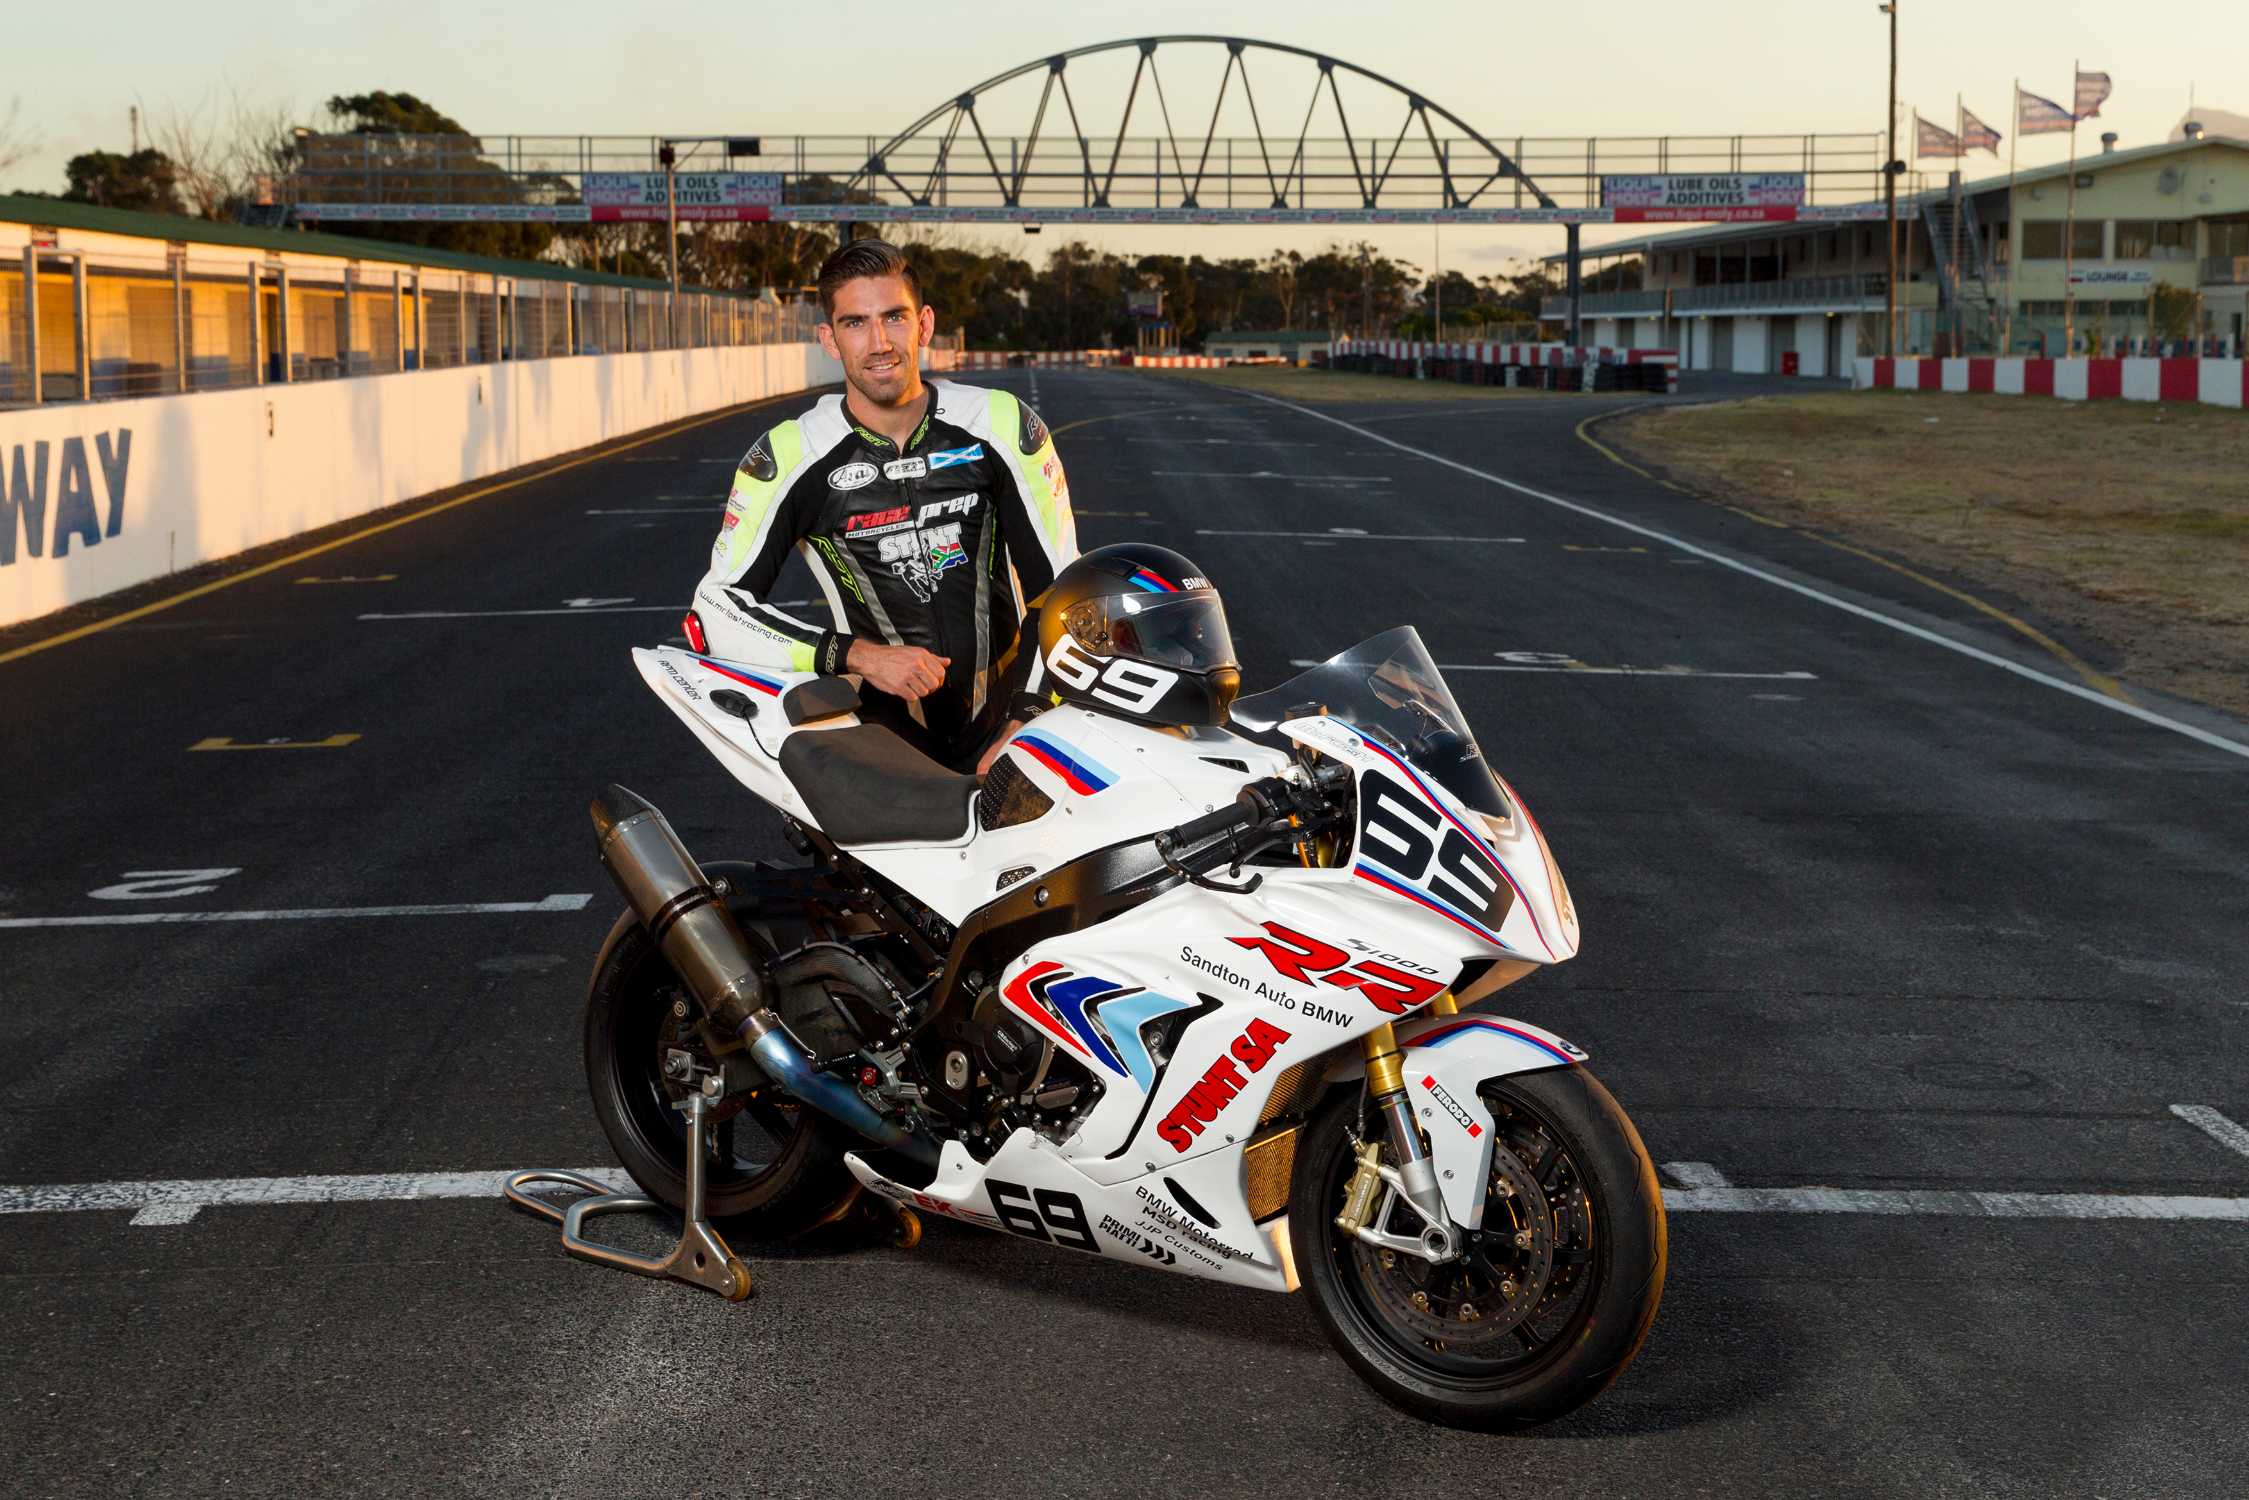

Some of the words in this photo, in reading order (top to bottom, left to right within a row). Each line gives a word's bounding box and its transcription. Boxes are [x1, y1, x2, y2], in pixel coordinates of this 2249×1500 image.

[645, 191, 721, 203] ADITIVES
[646, 176, 680, 189] LUE
[686, 176, 719, 190] OILS
[1666, 192, 1744, 205] ADDITIVES
[1668, 178, 1703, 191] LUBE
[1708, 177, 1742, 191] OILS
[0, 428, 132, 566] WAY
[916, 492, 979, 528] prep
[847, 522, 906, 538] MOTORCYCLES
[1182, 578, 1207, 591] BMW
[826, 634, 839, 673] RST
[1046, 633, 1179, 714] 69
[1359, 768, 1516, 933] 69
[1224, 920, 1448, 1016] RR
[1337, 938, 1440, 976] S1000
[1180, 946, 1250, 990] Sandton
[1255, 981, 1296, 1010] Auto
[1301, 1001, 1354, 1028] BMW
[1157, 1054, 1249, 1153] STUNT
[1231, 1017, 1292, 1074] SA
[1432, 1085, 1471, 1127] FERODO
[913, 1193, 958, 1218] EK
[984, 1178, 1102, 1253] 69
[1136, 1186, 1178, 1217] BMW
[1098, 1221, 1137, 1248] PIATTI
[1103, 1214, 1141, 1241] PRIMI
[1135, 1219, 1162, 1235] JJP
[1164, 1234, 1224, 1272] Customs
[1142, 1206, 1177, 1230] MSD
[1181, 1228, 1232, 1260] racing
